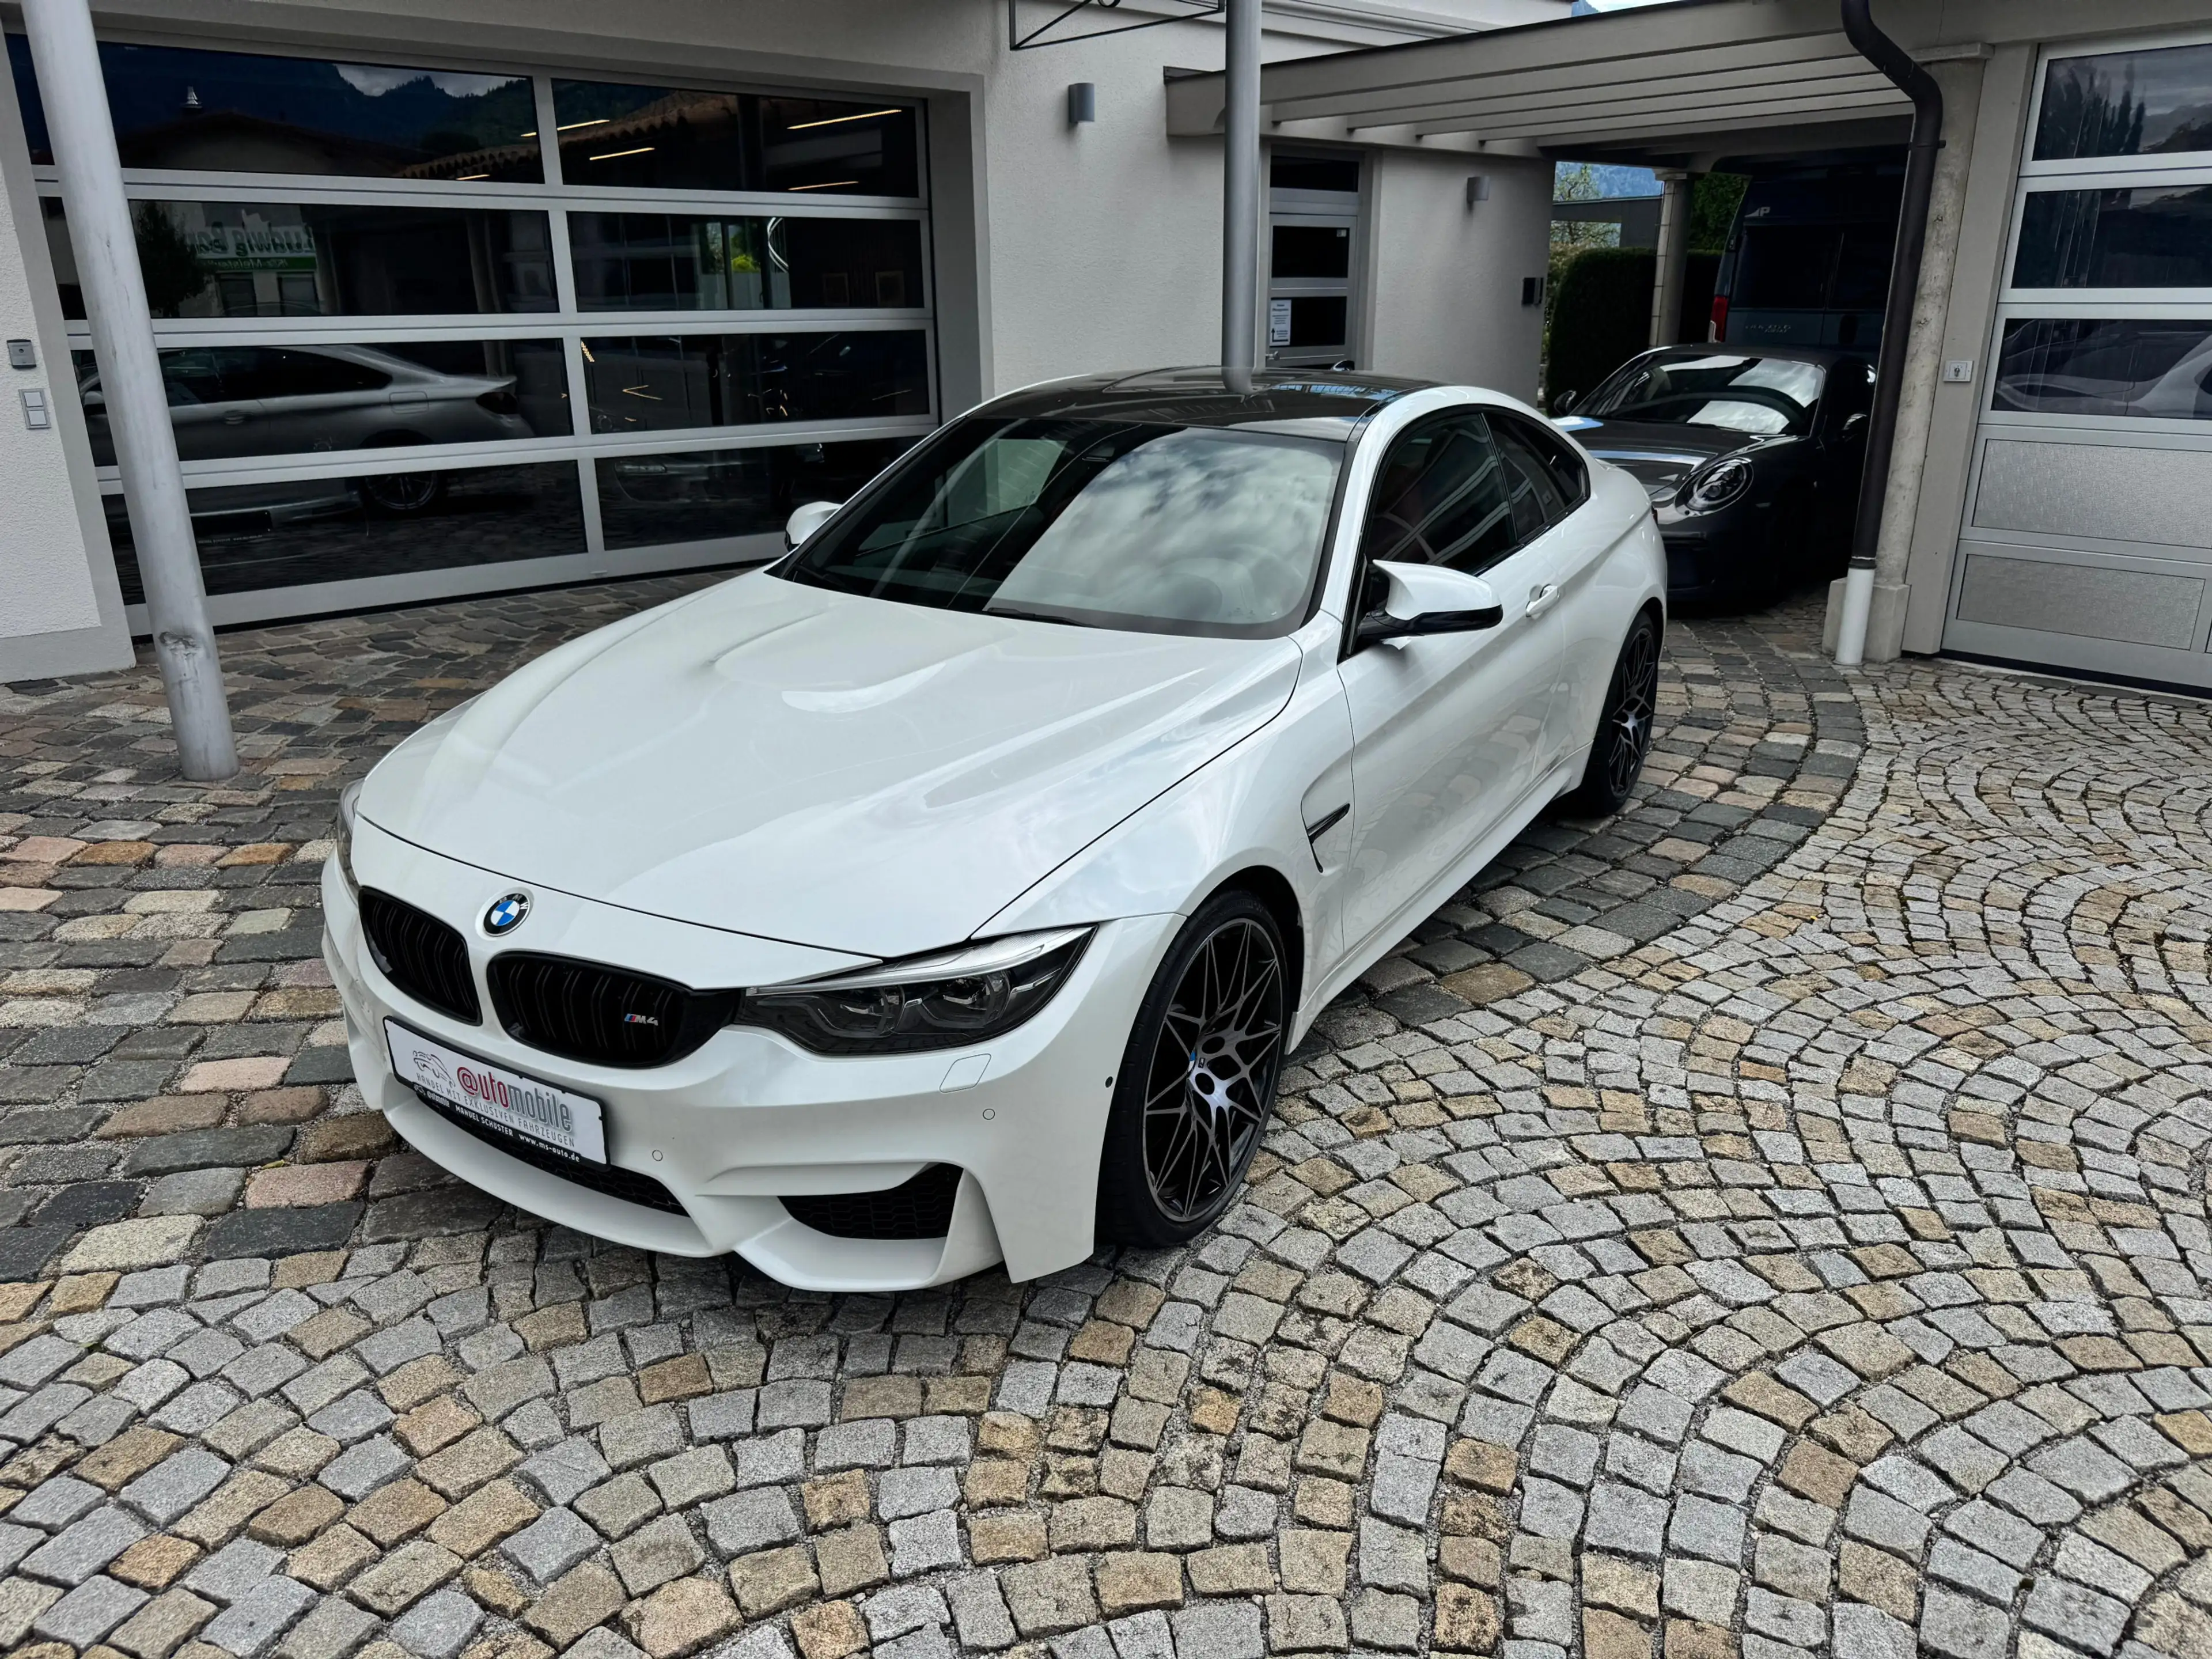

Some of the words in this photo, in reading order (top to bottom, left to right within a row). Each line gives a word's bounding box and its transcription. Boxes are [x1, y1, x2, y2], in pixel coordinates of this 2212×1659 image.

[499, 894, 529, 910] BMW
[634, 1014, 658, 1026] M4
[416, 1073, 444, 1093] HANDEL
[446, 1087, 460, 1101] MIT
[464, 1096, 514, 1123] EXKLUSIVEN
[518, 1118, 574, 1147] FAHRZEUGEN
[455, 1104, 479, 1122] MANUEL
[481, 1117, 513, 1137] SCHUSTER
[519, 1134, 580, 1162] www.ms-auto.de
